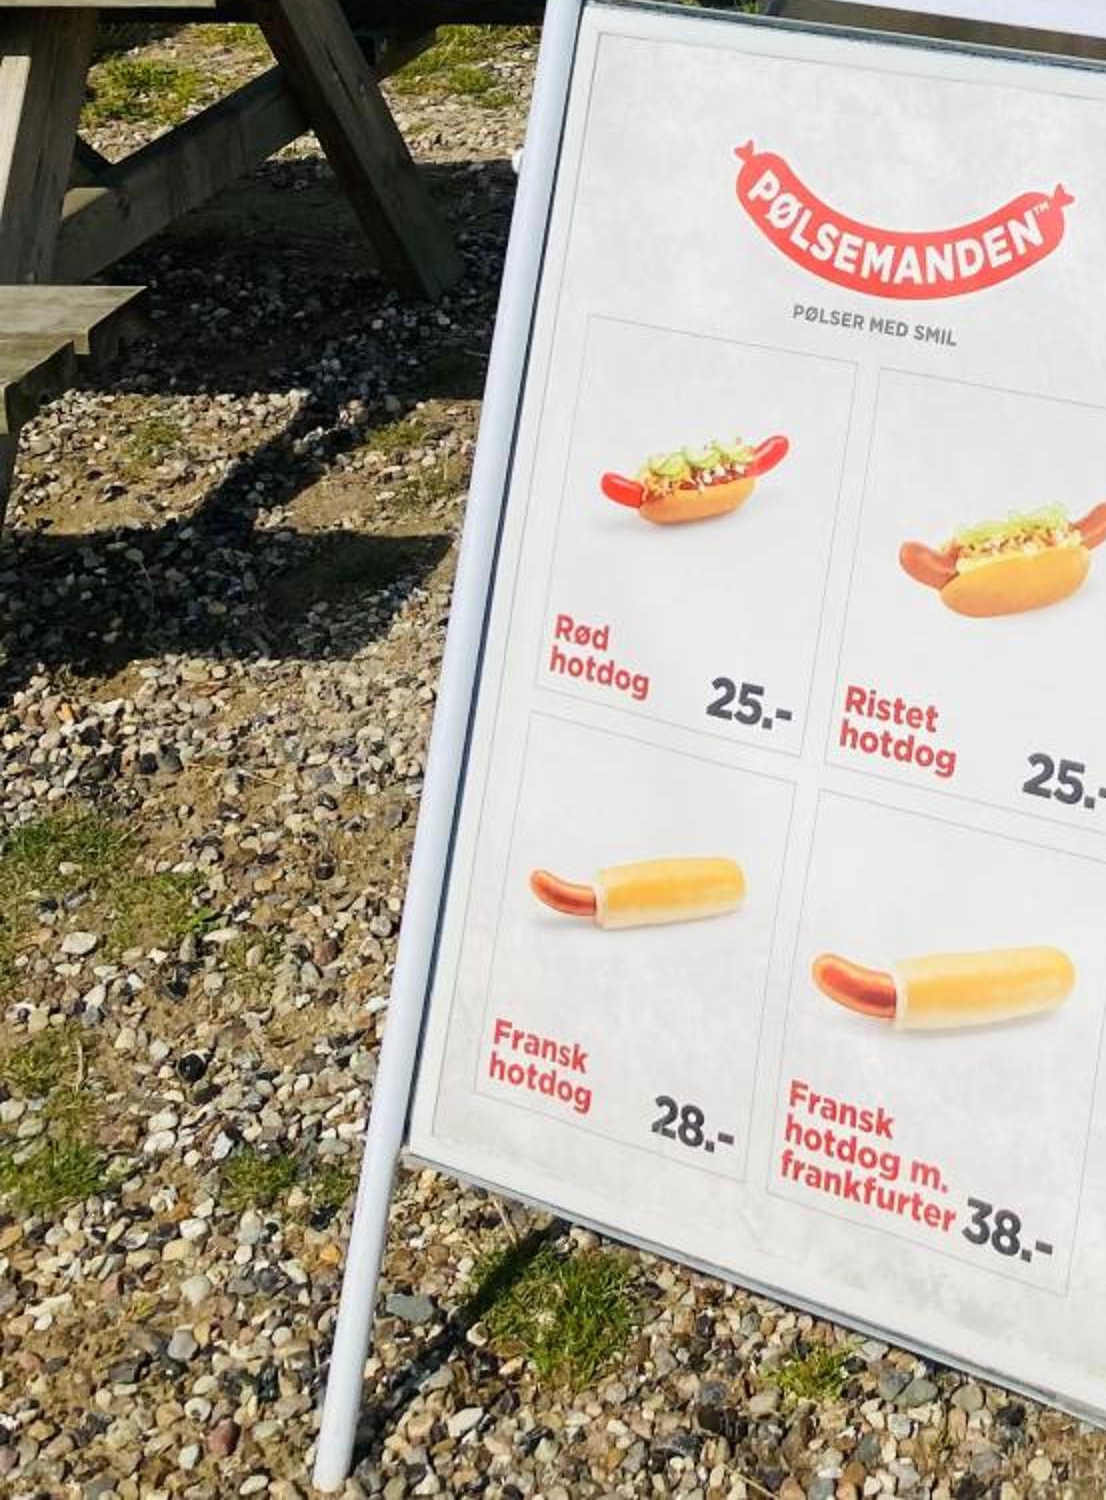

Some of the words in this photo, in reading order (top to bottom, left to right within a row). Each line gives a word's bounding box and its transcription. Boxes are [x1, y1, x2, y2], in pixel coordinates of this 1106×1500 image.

[793, 304, 865, 331] PØLSER
[869, 318, 909, 338] MED
[913, 324, 957, 346] SMIL
[554, 613, 611, 651] Rød
[549, 646, 650, 702] hotdog
[705, 676, 793, 730] 25.-
[844, 684, 940, 733] Ristet
[839, 719, 957, 779] hotdog
[493, 1017, 590, 1075] Fransk
[489, 1051, 593, 1115] hotdog
[788, 1079, 896, 1141] Fransk
[651, 1094, 735, 1153] 28.-
[784, 1113, 901, 1182] hotdog
[910, 1158, 949, 1194] m.
[780, 1149, 957, 1233] frankfurter
[961, 1196, 1053, 1263] 38.-
